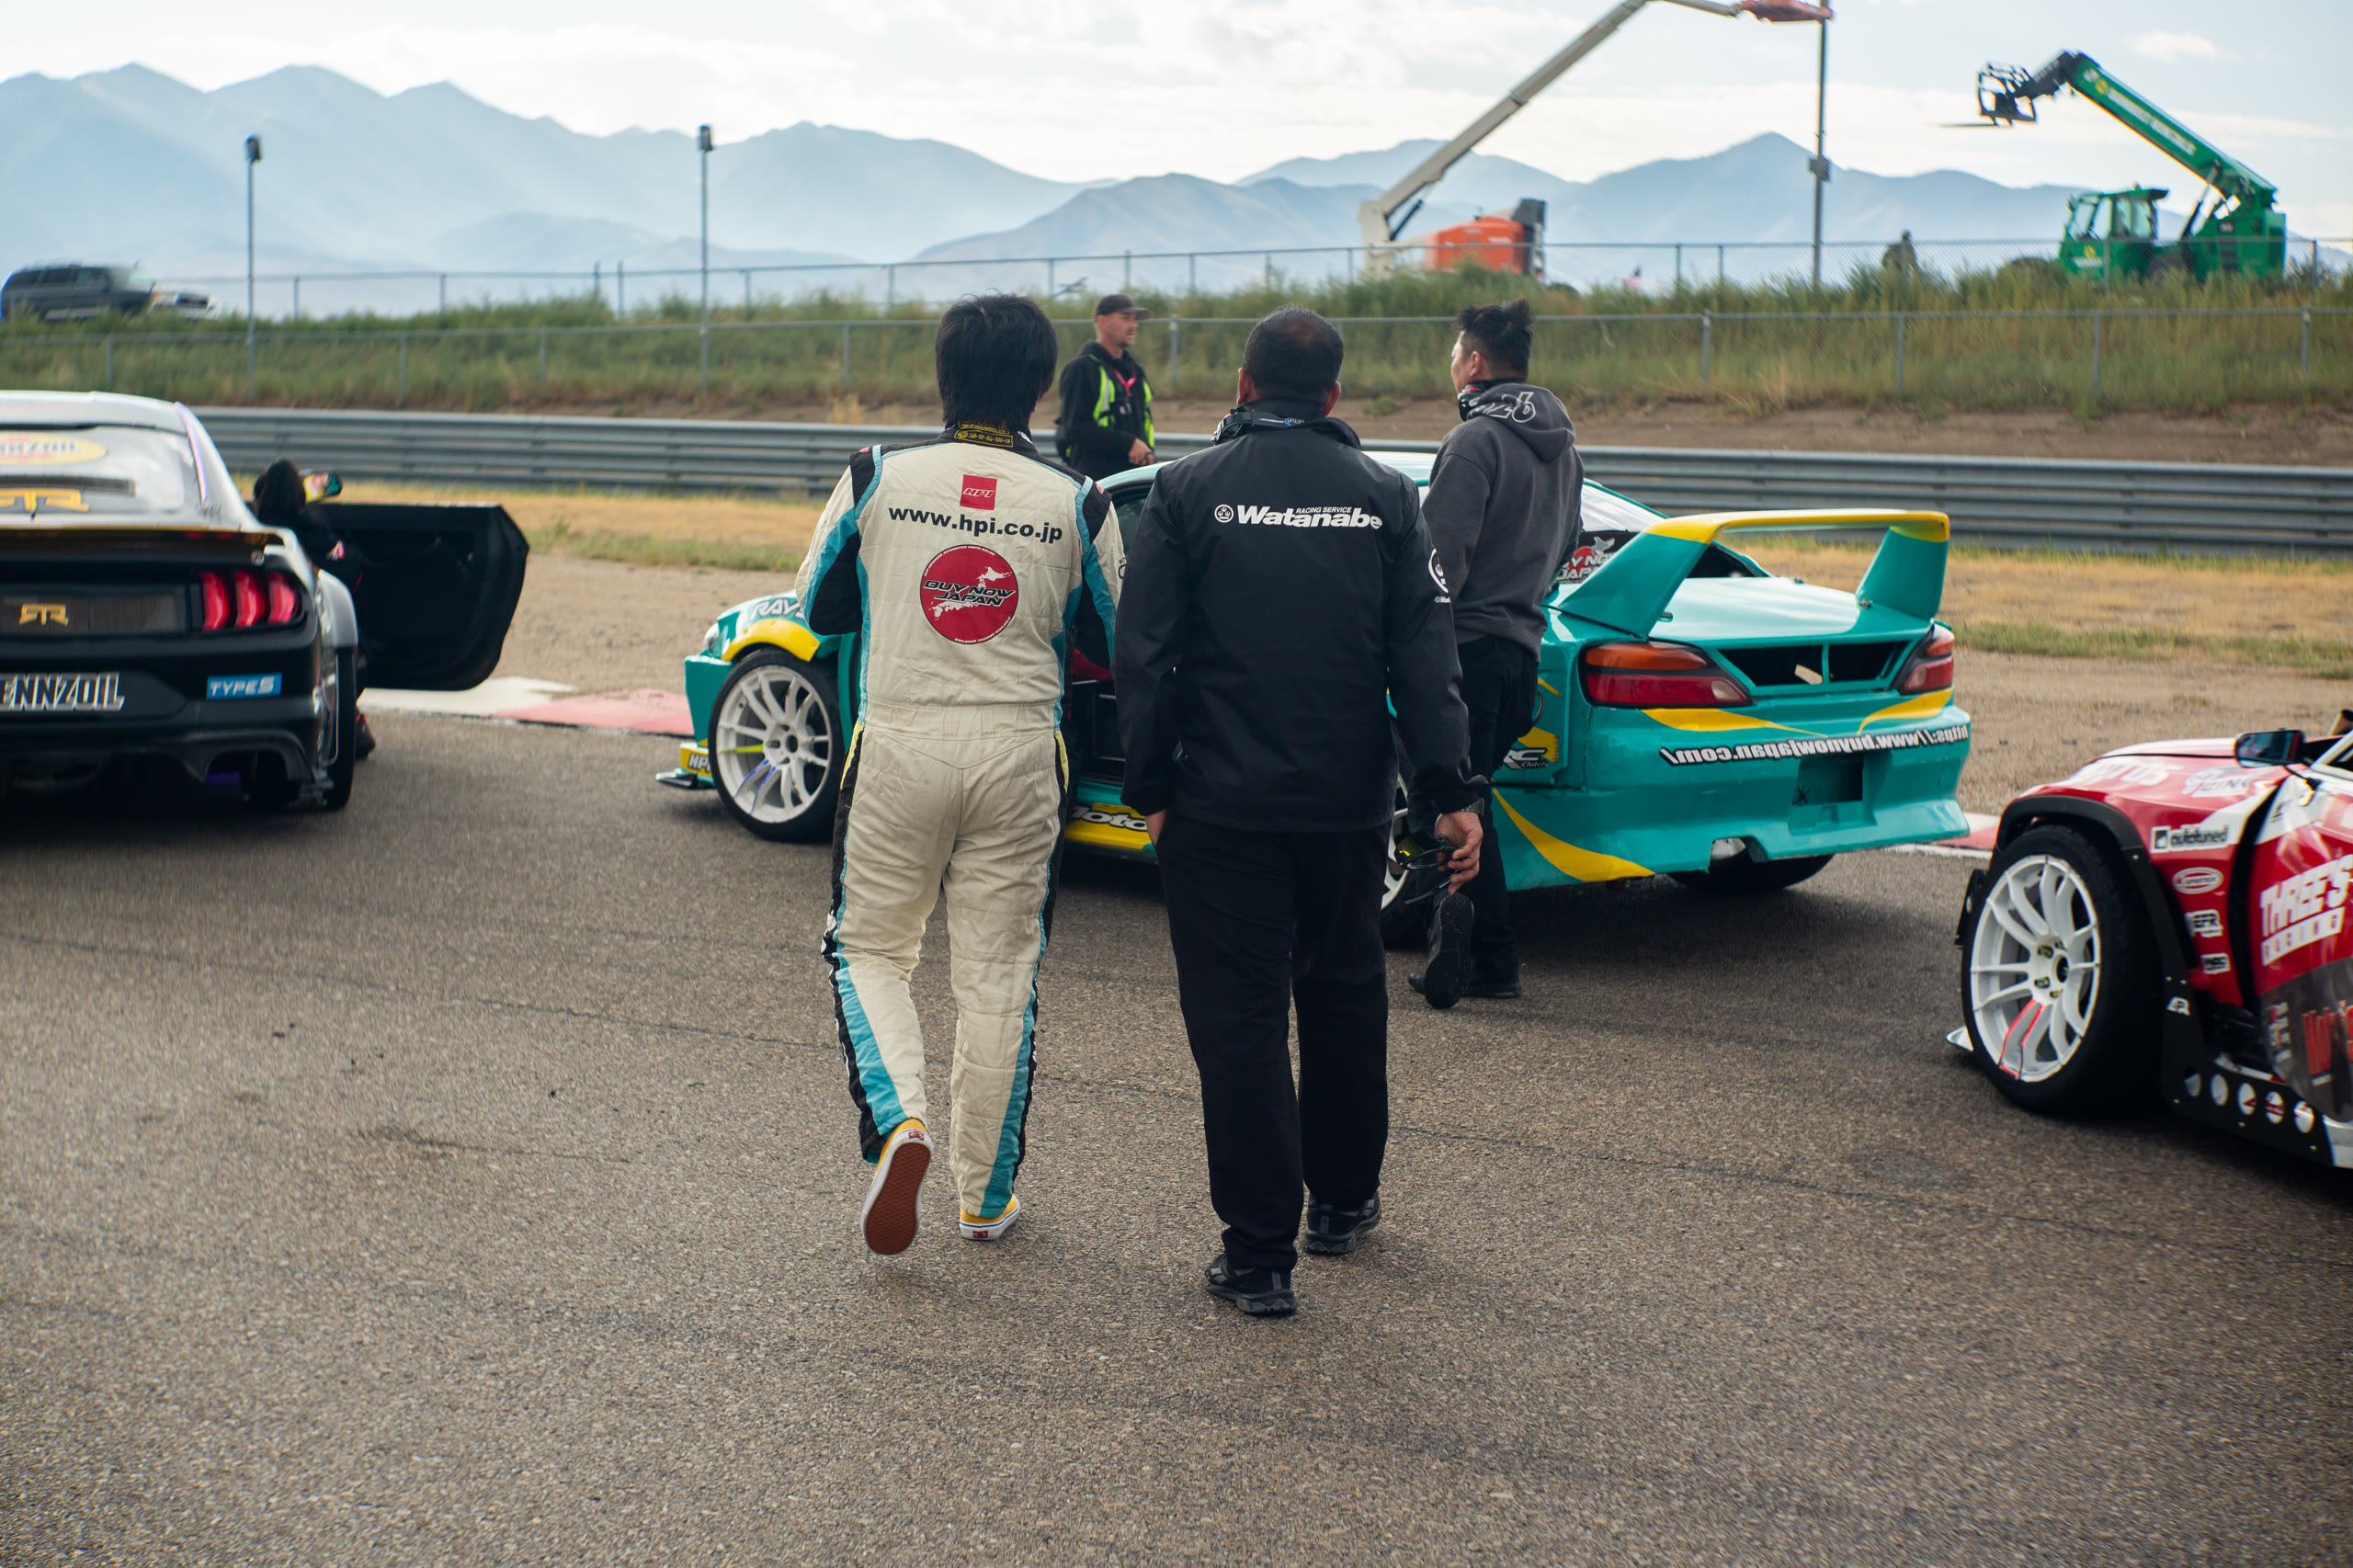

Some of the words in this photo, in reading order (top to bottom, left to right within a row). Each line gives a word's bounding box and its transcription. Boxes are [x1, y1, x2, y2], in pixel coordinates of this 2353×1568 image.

[962, 487, 995, 498] HPI
[888, 507, 1063, 544] www.hpi.co.jp
[1237, 505, 1383, 529] Watanabe
[923, 580, 970, 594] BUY
[968, 585, 1017, 598] NOW
[934, 591, 1004, 608] JAPAN
